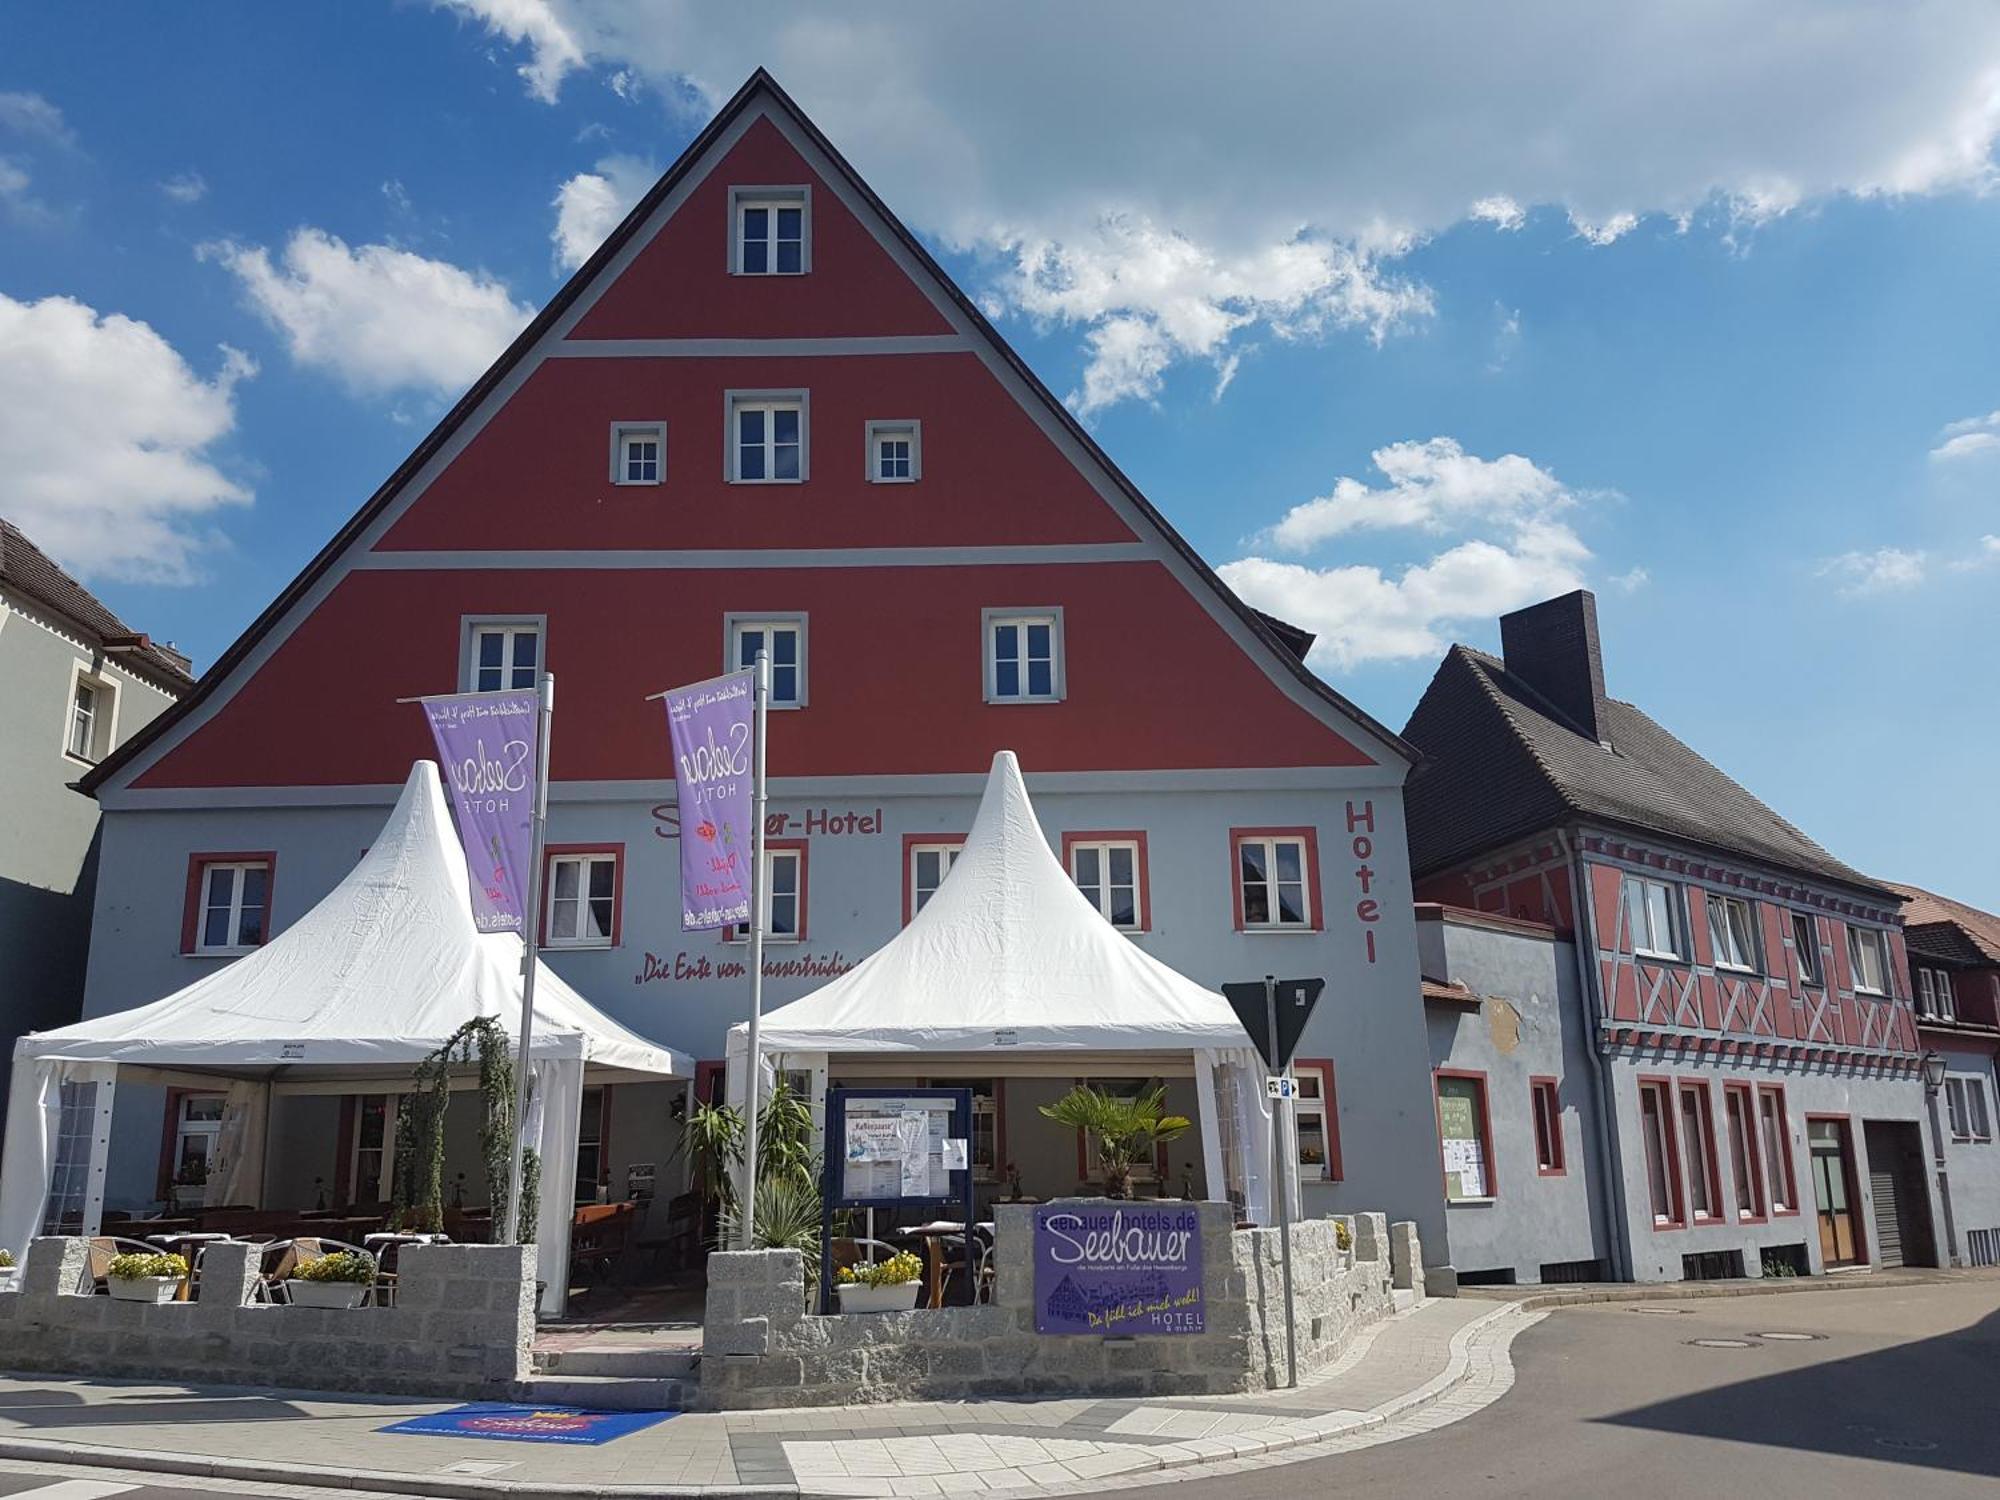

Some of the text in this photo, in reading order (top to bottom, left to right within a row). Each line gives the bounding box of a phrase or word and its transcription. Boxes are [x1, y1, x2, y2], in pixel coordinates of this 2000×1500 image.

[1346, 800, 1380, 963] Hotel
[674, 952, 712, 980] Ente
[717, 962, 746, 979] von
[1046, 1210, 1191, 1263] Seebauer
[1147, 1294, 1170, 1312] mich
[1151, 1313, 1203, 1325] HOTEL
